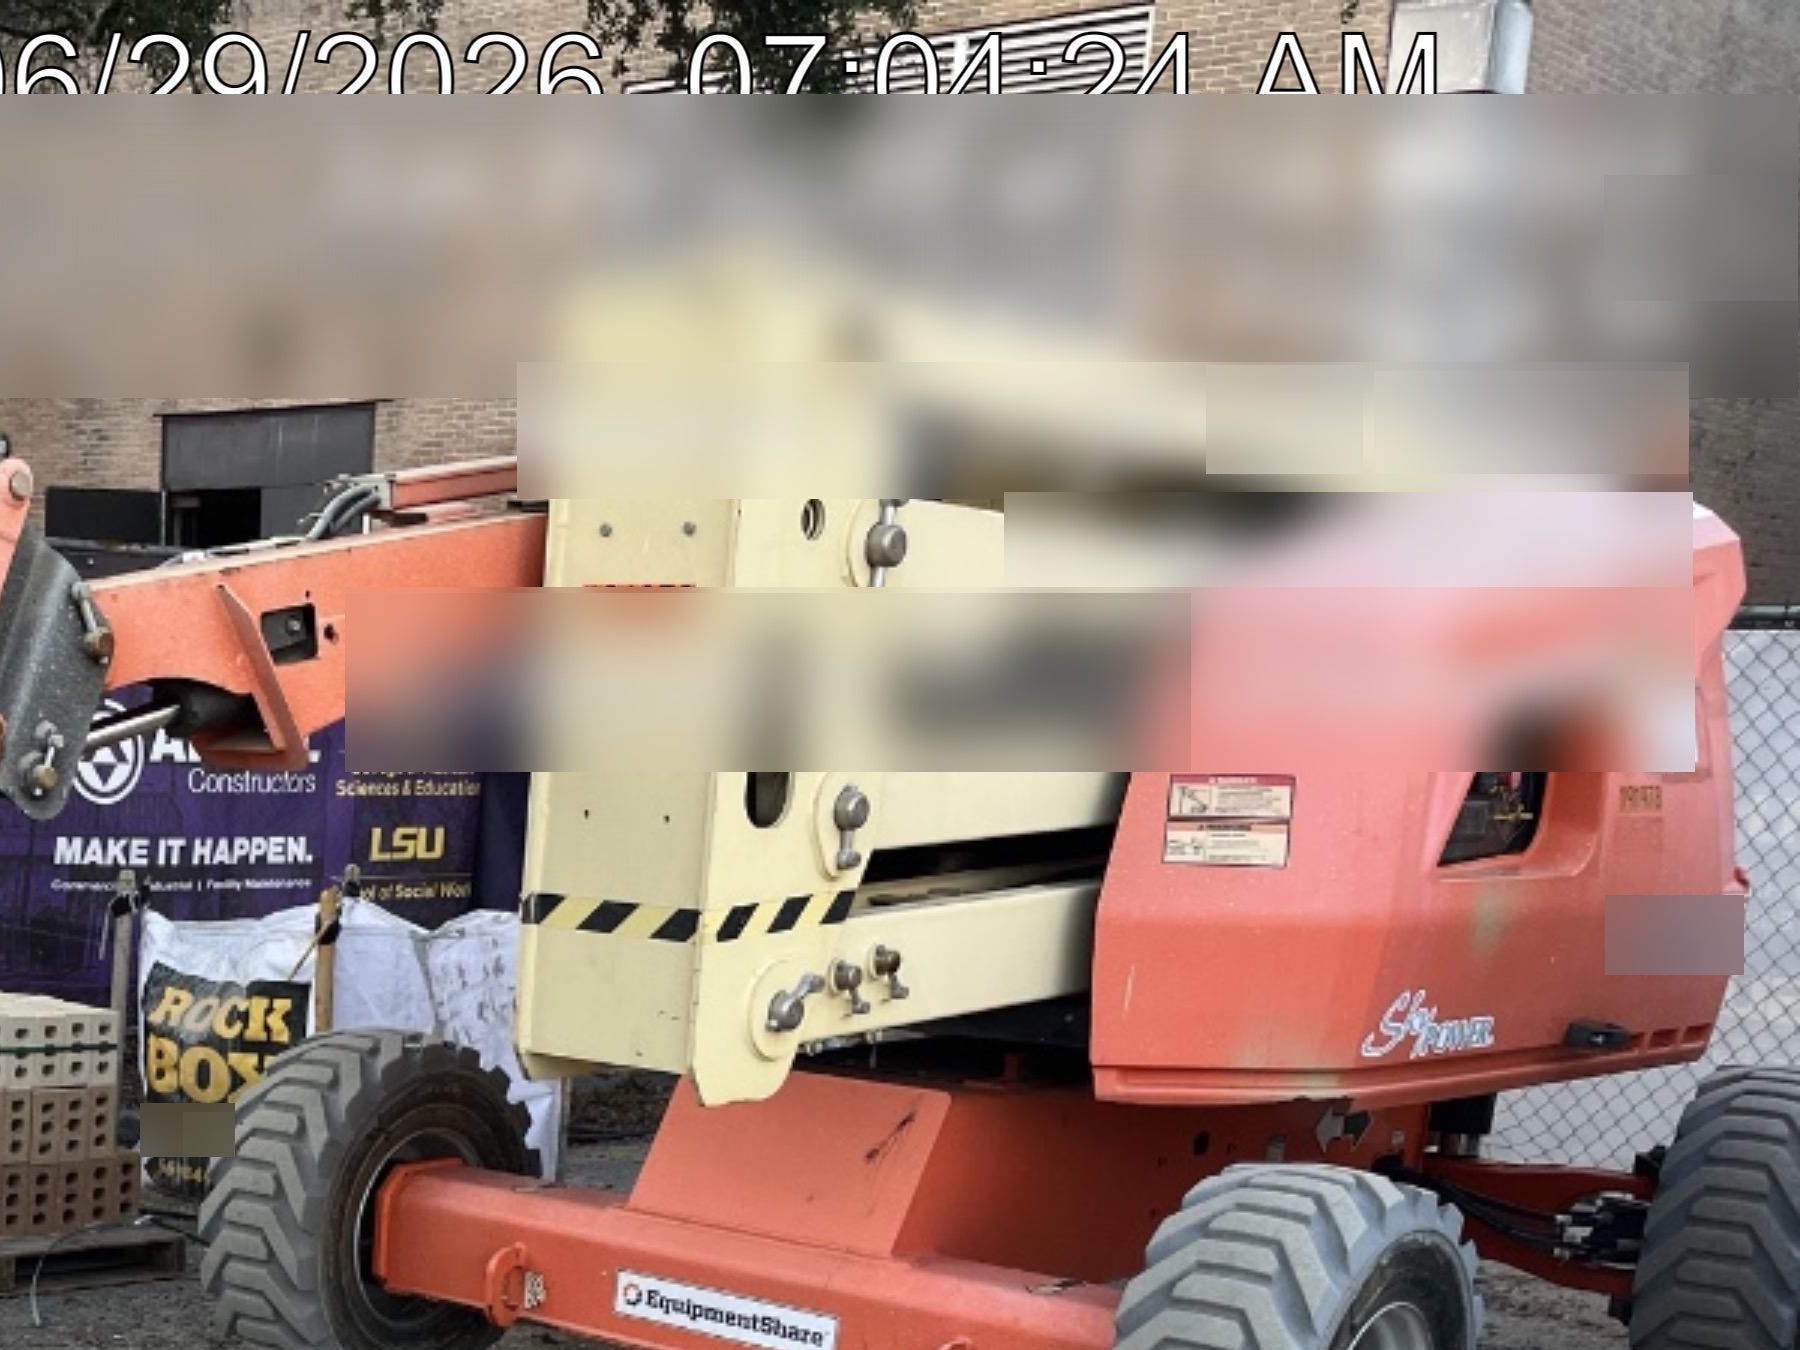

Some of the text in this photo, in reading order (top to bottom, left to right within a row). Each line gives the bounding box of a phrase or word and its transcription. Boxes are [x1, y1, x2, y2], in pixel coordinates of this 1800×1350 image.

[188, 767, 316, 793] Constructors
[335, 780, 399, 796] Sciences
[401, 781, 412, 796] &
[53, 836, 314, 866] MAKE IT HAPPEN.
[368, 826, 445, 862] LSU
[395, 883, 436, 899] Social
[148, 986, 292, 1043] ROCK
[646, 1289, 825, 1347] EquipmentShare
